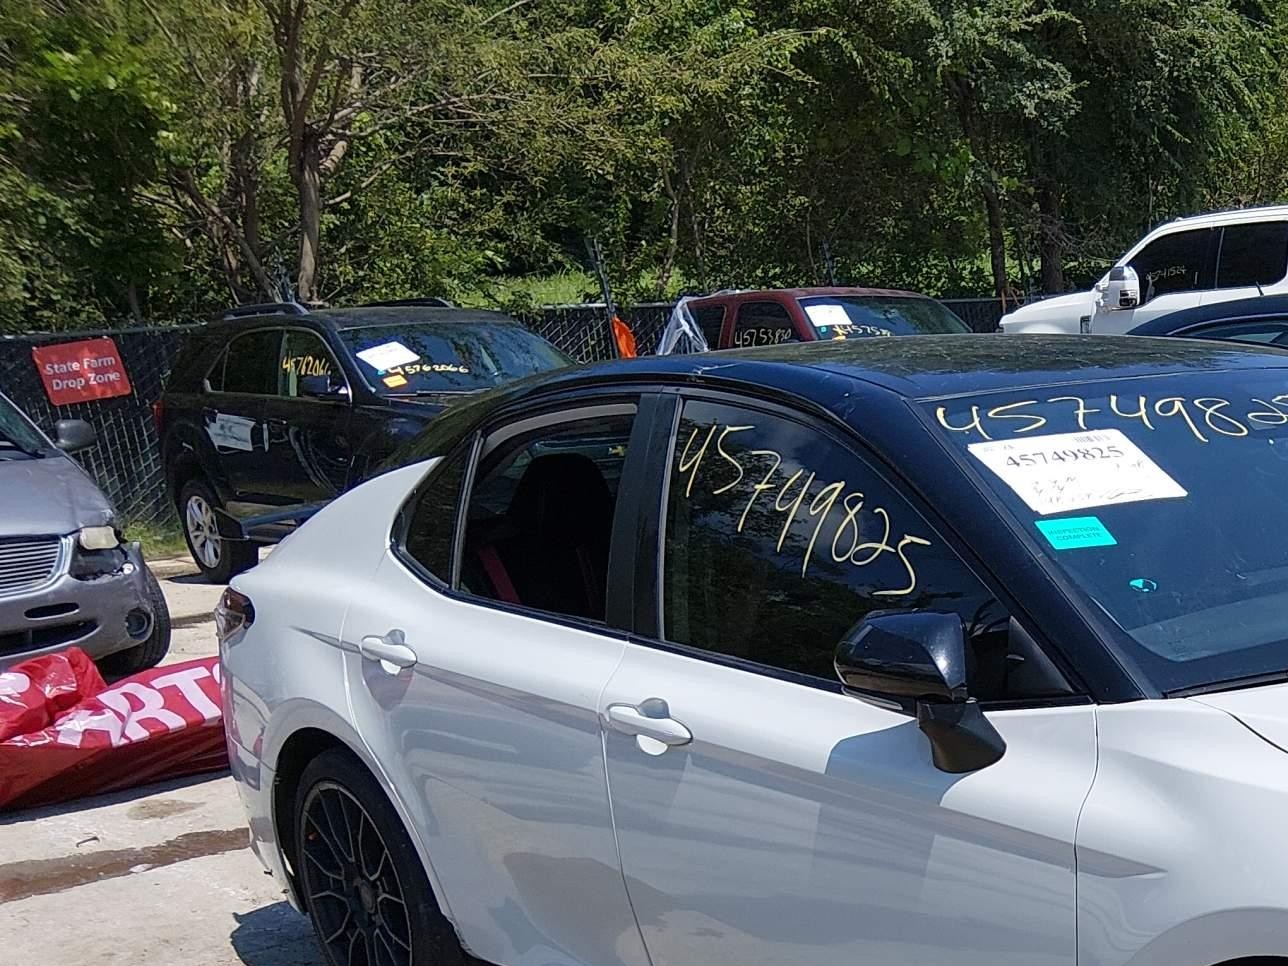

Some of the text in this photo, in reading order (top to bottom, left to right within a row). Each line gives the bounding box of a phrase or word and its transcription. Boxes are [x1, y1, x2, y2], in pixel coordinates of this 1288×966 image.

[45, 356, 116, 375] State Farm
[387, 364, 470, 375] 45762066
[52, 371, 121, 390] Drop Zone
[1006, 446, 1124, 468] 45749825
[679, 425, 932, 596] 45749825
[1048, 526, 1101, 535] INSPECTION
[1056, 533, 1104, 541] COMPLETE
